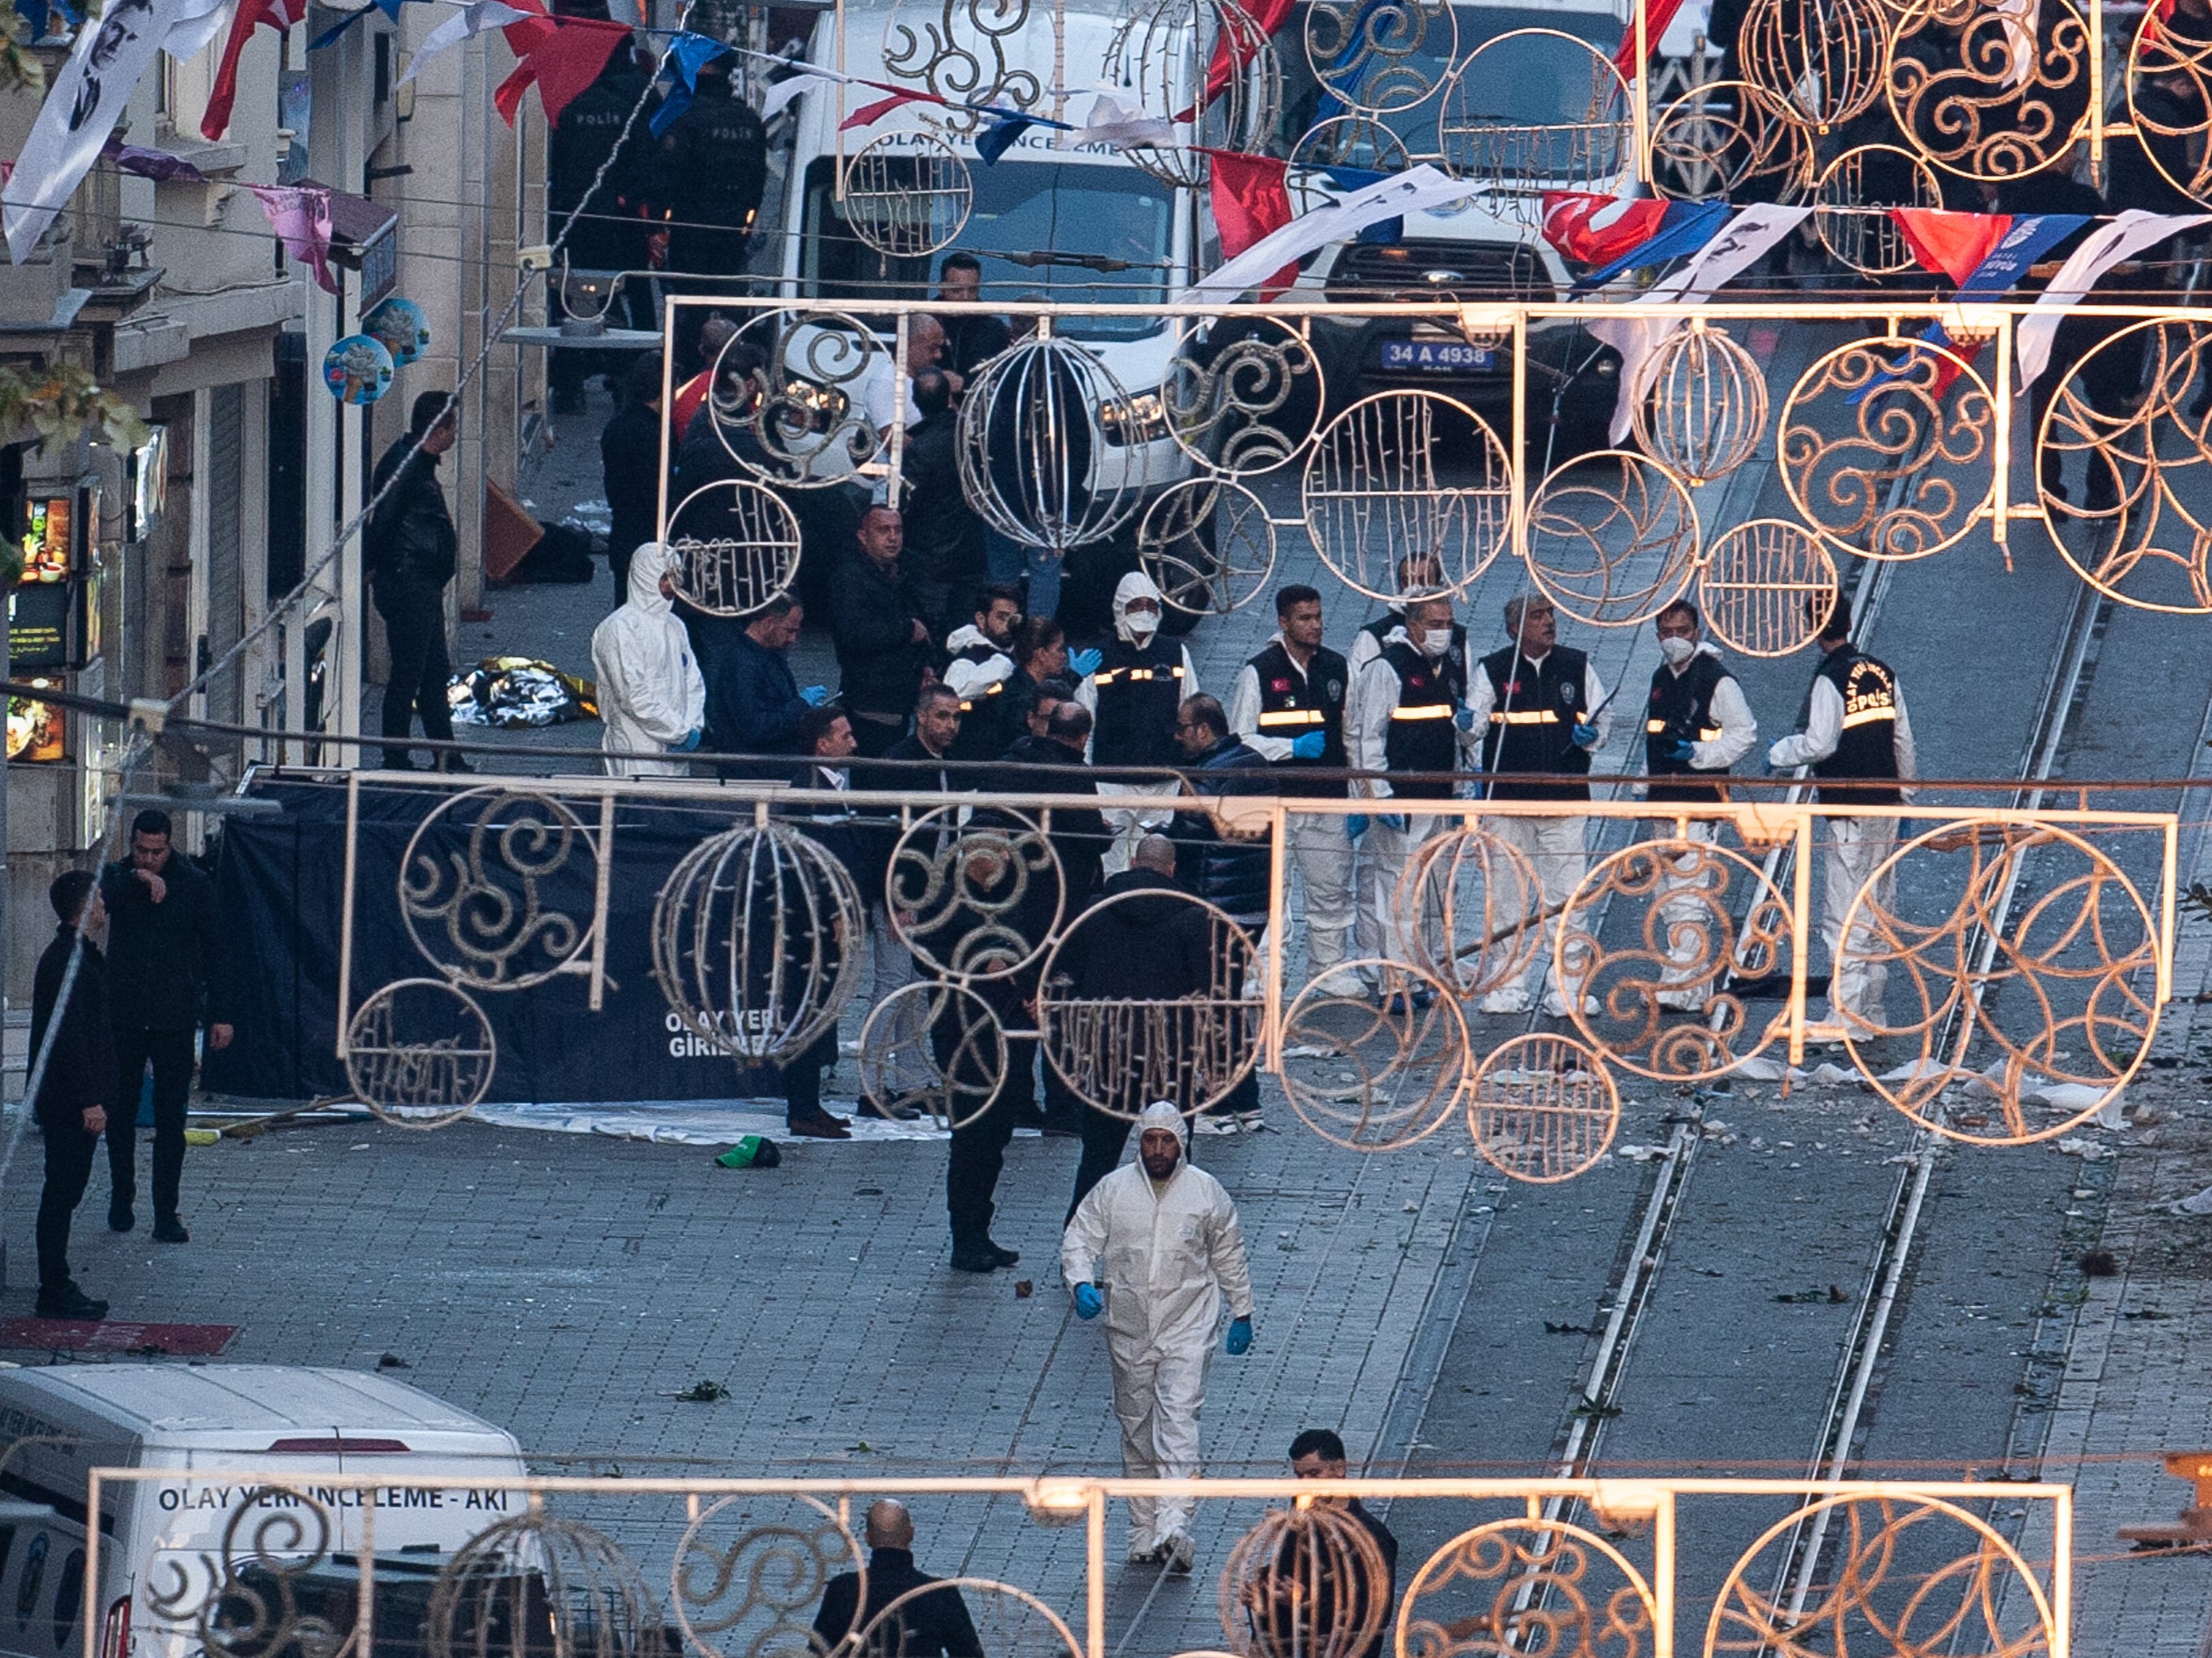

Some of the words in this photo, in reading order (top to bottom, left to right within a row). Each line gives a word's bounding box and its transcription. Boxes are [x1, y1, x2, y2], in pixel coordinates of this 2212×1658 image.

[1390, 345, 1413, 362] 34
[1418, 346, 1433, 362] A
[1438, 347, 1486, 363] 4938
[159, 1486, 231, 1511] OLAY
